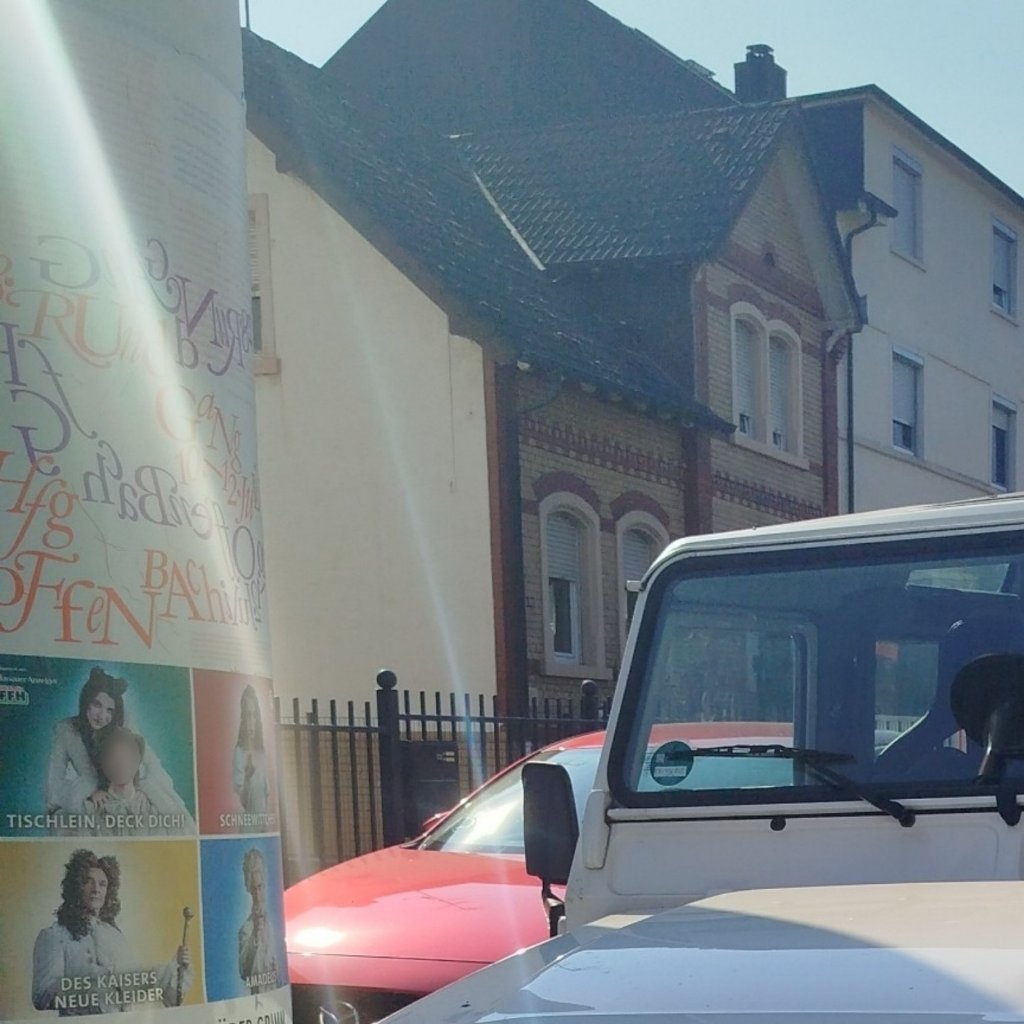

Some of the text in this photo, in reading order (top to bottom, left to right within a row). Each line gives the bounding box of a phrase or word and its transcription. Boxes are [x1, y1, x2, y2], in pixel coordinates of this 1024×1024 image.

[7, 812, 186, 831] TISCHLEIN, DECK DICH!
[61, 971, 158, 992] DES KAISERS
[55, 987, 165, 1010] NEUE KLEIDER
